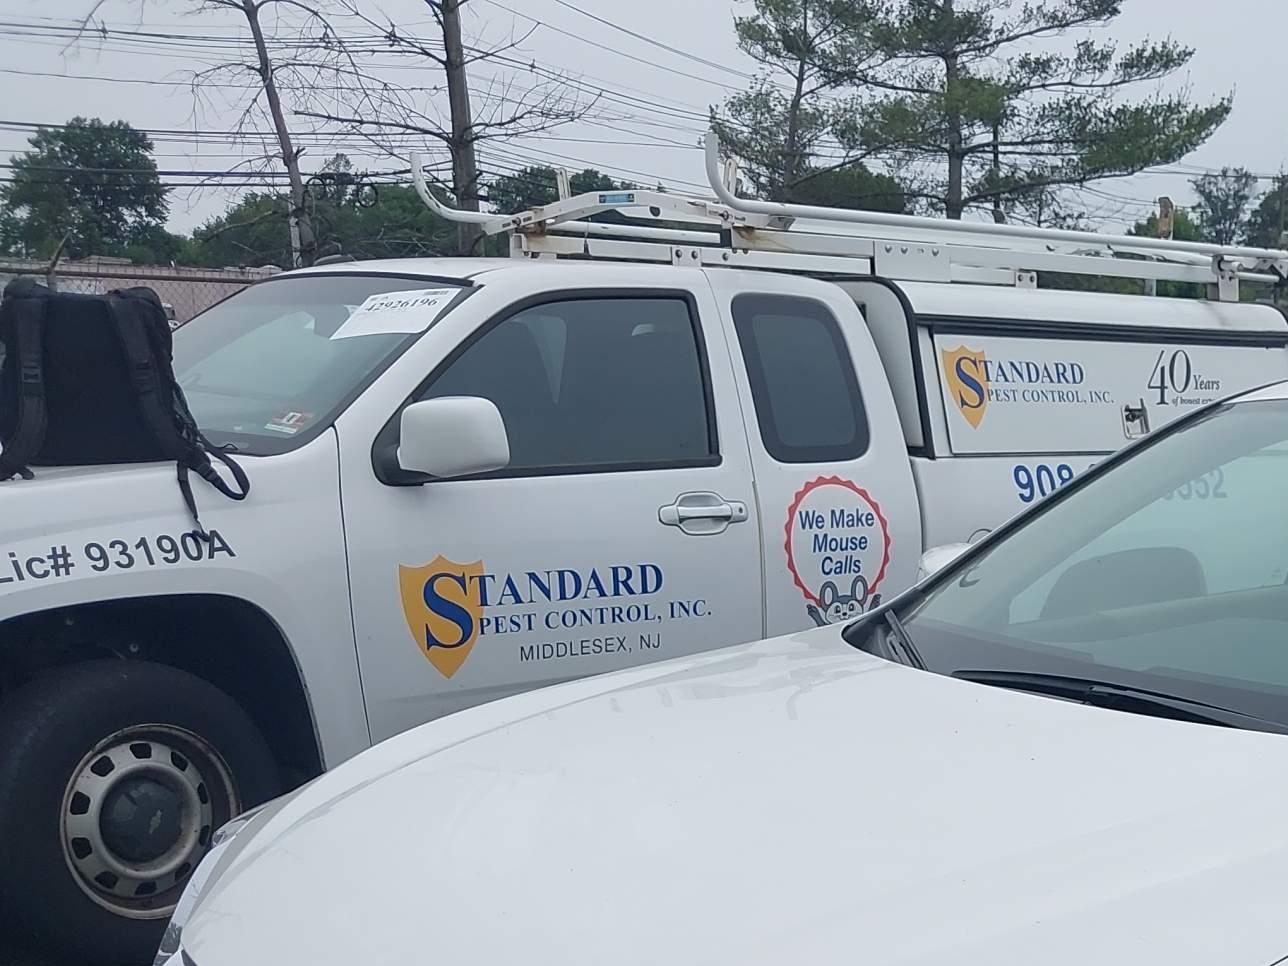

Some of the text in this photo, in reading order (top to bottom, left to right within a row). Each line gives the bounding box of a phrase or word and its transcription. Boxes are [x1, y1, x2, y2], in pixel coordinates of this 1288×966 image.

[955, 356, 1084, 409] STANDARD
[1147, 350, 1220, 405] 40 Years
[987, 388, 1114, 404] PEST CONTROL, INC.
[799, 508, 875, 530] We Make
[84, 530, 236, 571] 93190A
[813, 533, 868, 553] Mouse
[821, 555, 861, 575] Calls
[422, 564, 664, 650] STANDARD
[479, 599, 712, 635] PEST CONTROL, INC.
[520, 633, 661, 661] MIDDLESEX, NJ
